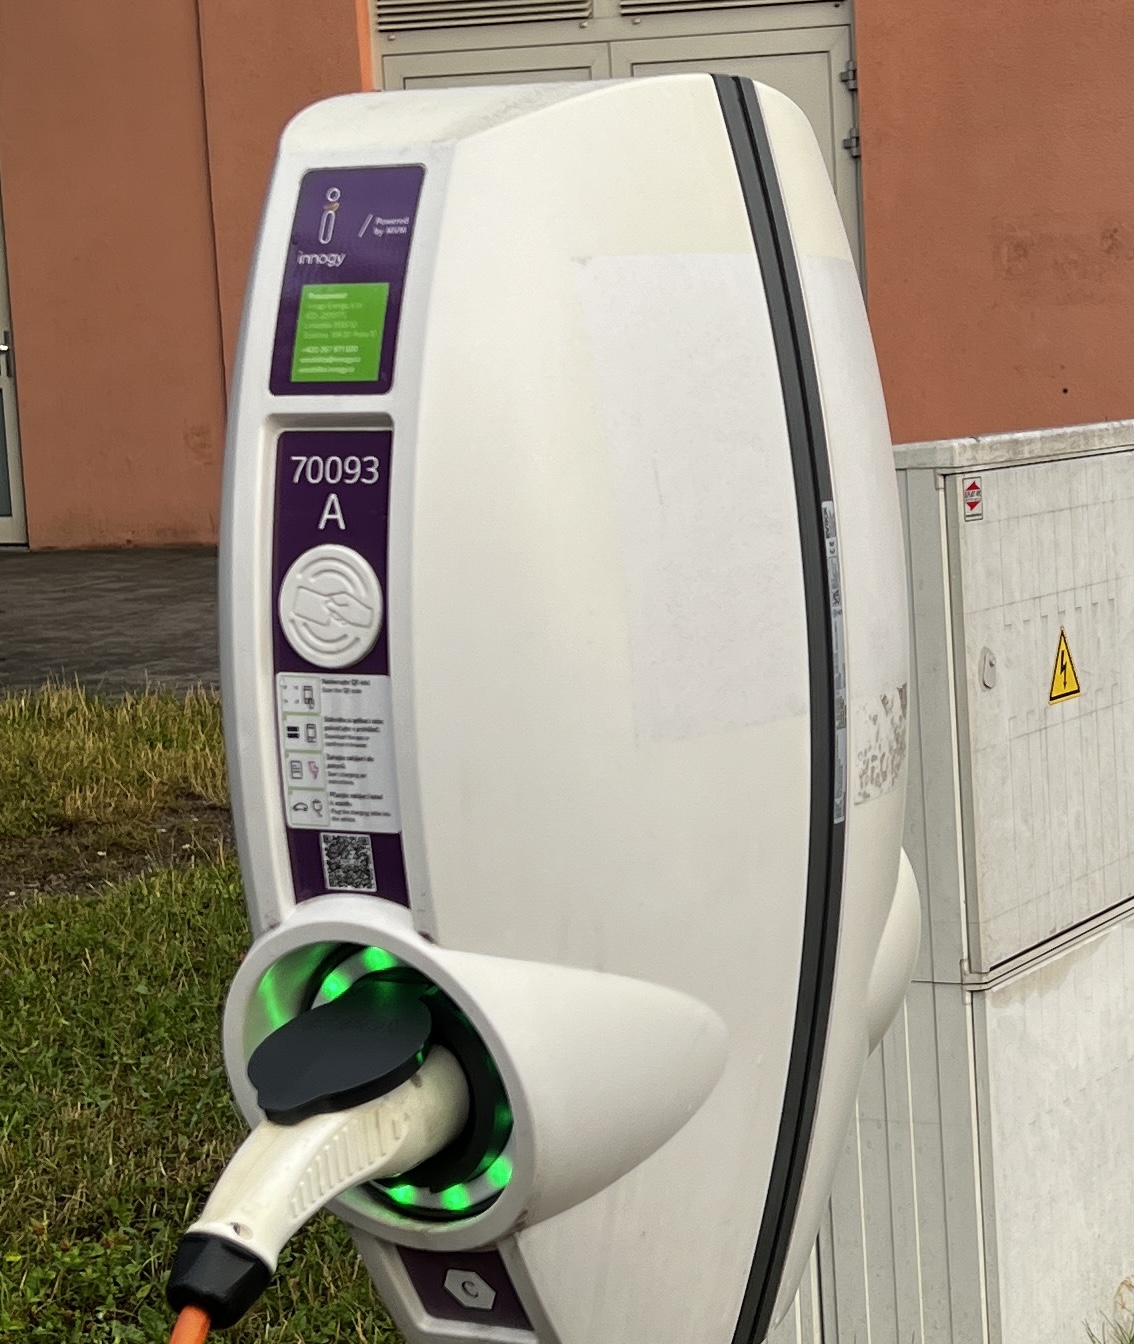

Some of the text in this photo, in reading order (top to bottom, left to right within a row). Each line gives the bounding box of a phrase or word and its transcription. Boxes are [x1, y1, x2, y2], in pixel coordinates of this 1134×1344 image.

[297, 250, 346, 268] innogy
[289, 455, 381, 485] 70093
[317, 492, 347, 531] A
